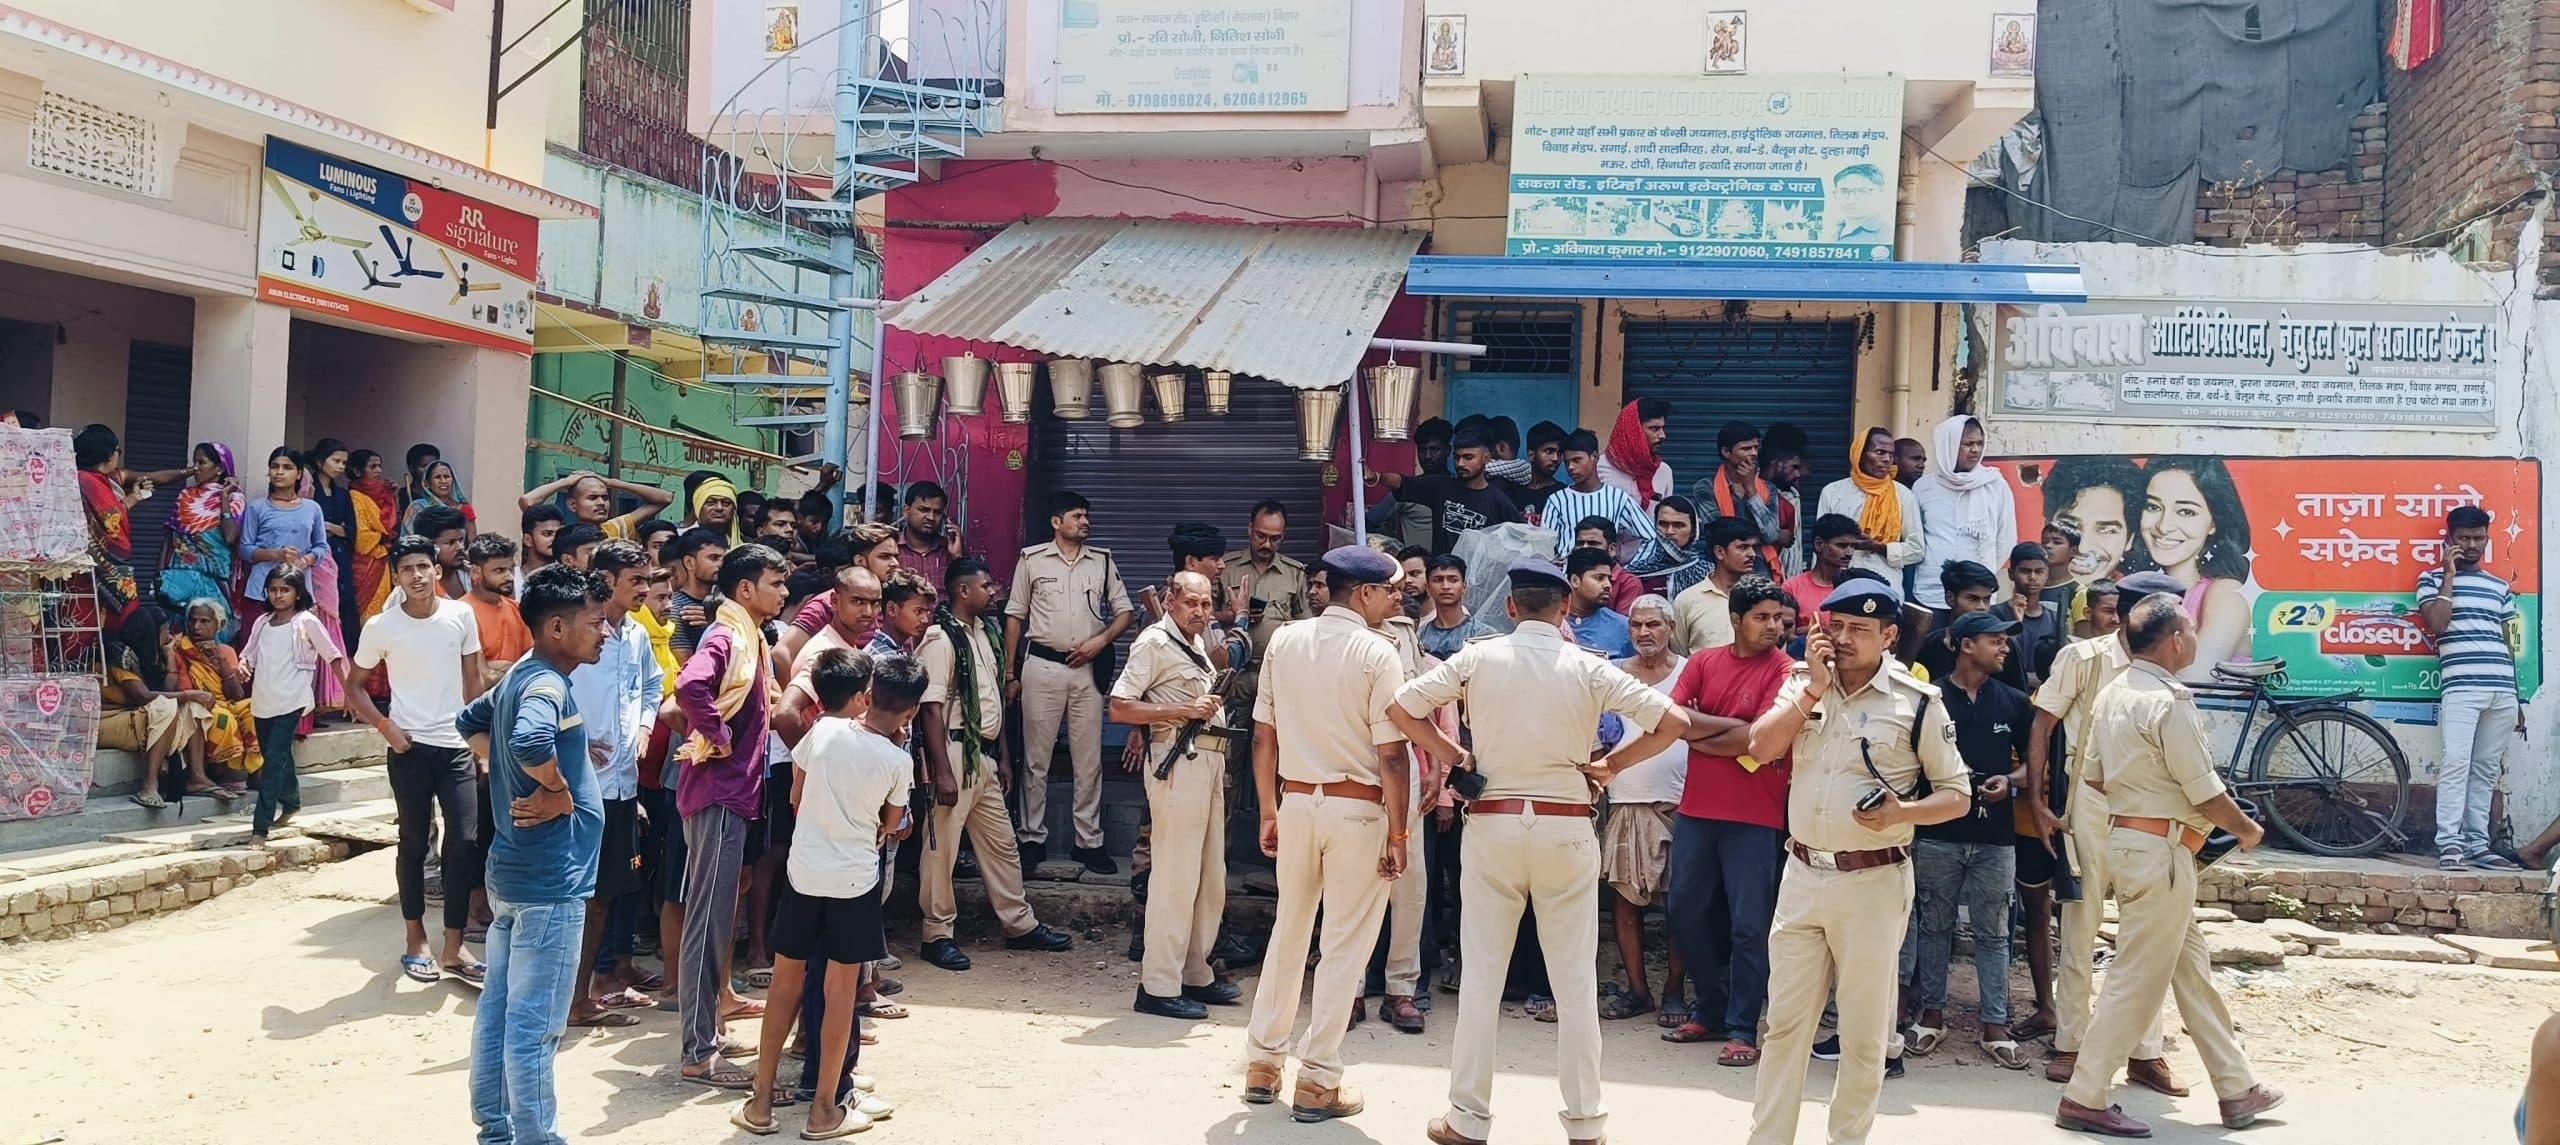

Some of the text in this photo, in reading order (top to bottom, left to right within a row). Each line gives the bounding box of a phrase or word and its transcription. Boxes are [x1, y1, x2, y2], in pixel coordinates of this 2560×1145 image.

[1148, 30, 1168, 43] रवि
[1210, 28, 1250, 42] नितिश
[1254, 27, 1285, 41] सोनी
[1128, 92, 1218, 109] 9798696024,
[1223, 91, 1308, 106] 6206412965
[1525, 125, 1548, 136] नोट-
[1550, 126, 1575, 137] हमारे
[1577, 125, 1596, 136] यहाँ
[1597, 125, 1618, 136] सभी
[1619, 128, 1645, 138] प्रकार
[1647, 126, 1658, 137] के
[1830, 128, 1859, 139] तिलक
[1542, 141, 1569, 153] विवाह
[1634, 141, 1656, 153] शादी
[1699, 159, 1730, 170] इत्यादि
[1733, 161, 1766, 171] सजाया
[1768, 161, 1792, 171] जाता
[320, 163, 377, 194] LUMINOUS
[1517, 177, 1560, 190] सकला
[1769, 178, 1784, 192] के
[1787, 180, 1817, 193] पास
[329, 183, 376, 204] Fans Lighting
[404, 205, 420, 215] NOW
[459, 205, 486, 230] RR
[1552, 240, 1604, 255] अविनाश
[1607, 244, 1644, 259] कुमार
[1679, 244, 1770, 260] 9122907060,
[1774, 246, 1860, 259] 7491857841
[2004, 304, 2148, 369] अविनाश
[2278, 307, 2337, 374] नेचुरल
[2338, 320, 2376, 376] फूल
[2377, 321, 2444, 362] सजावट
[2445, 311, 2487, 366] केन्द्र
[2147, 375, 2167, 386] हमारे
[2359, 379, 2383, 390] तिलक
[2374, 396, 2394, 405] जाता
[2459, 398, 2479, 407] जाता
[2295, 493, 2386, 523] ताज़ा
[2298, 527, 2492, 568] सफ़ेद दां।
[2324, 621, 2422, 651] closeup
